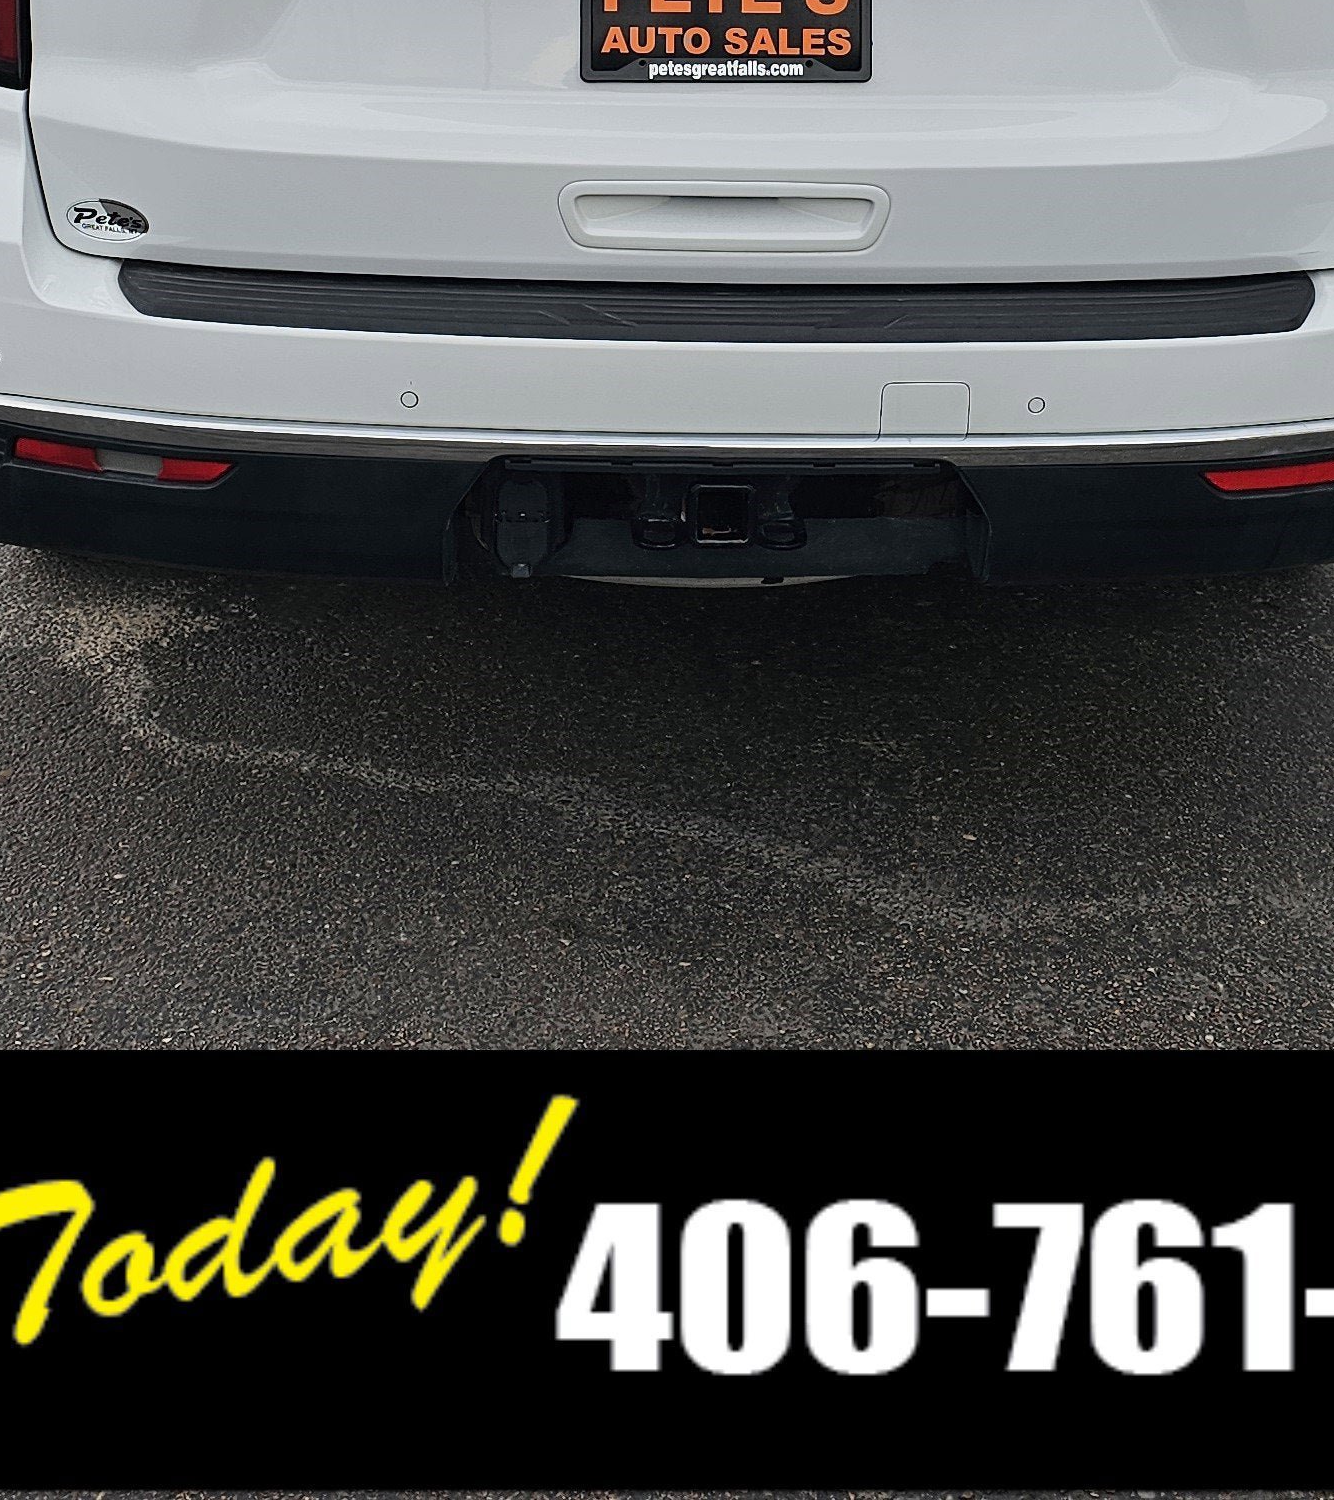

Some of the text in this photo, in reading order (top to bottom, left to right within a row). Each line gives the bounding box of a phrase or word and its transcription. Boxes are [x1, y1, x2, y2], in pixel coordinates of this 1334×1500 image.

[601, 26, 852, 56] AUTO SALES
[648, 58, 804, 80] petesgreatfalls.com
[73, 206, 143, 229] Pete's
